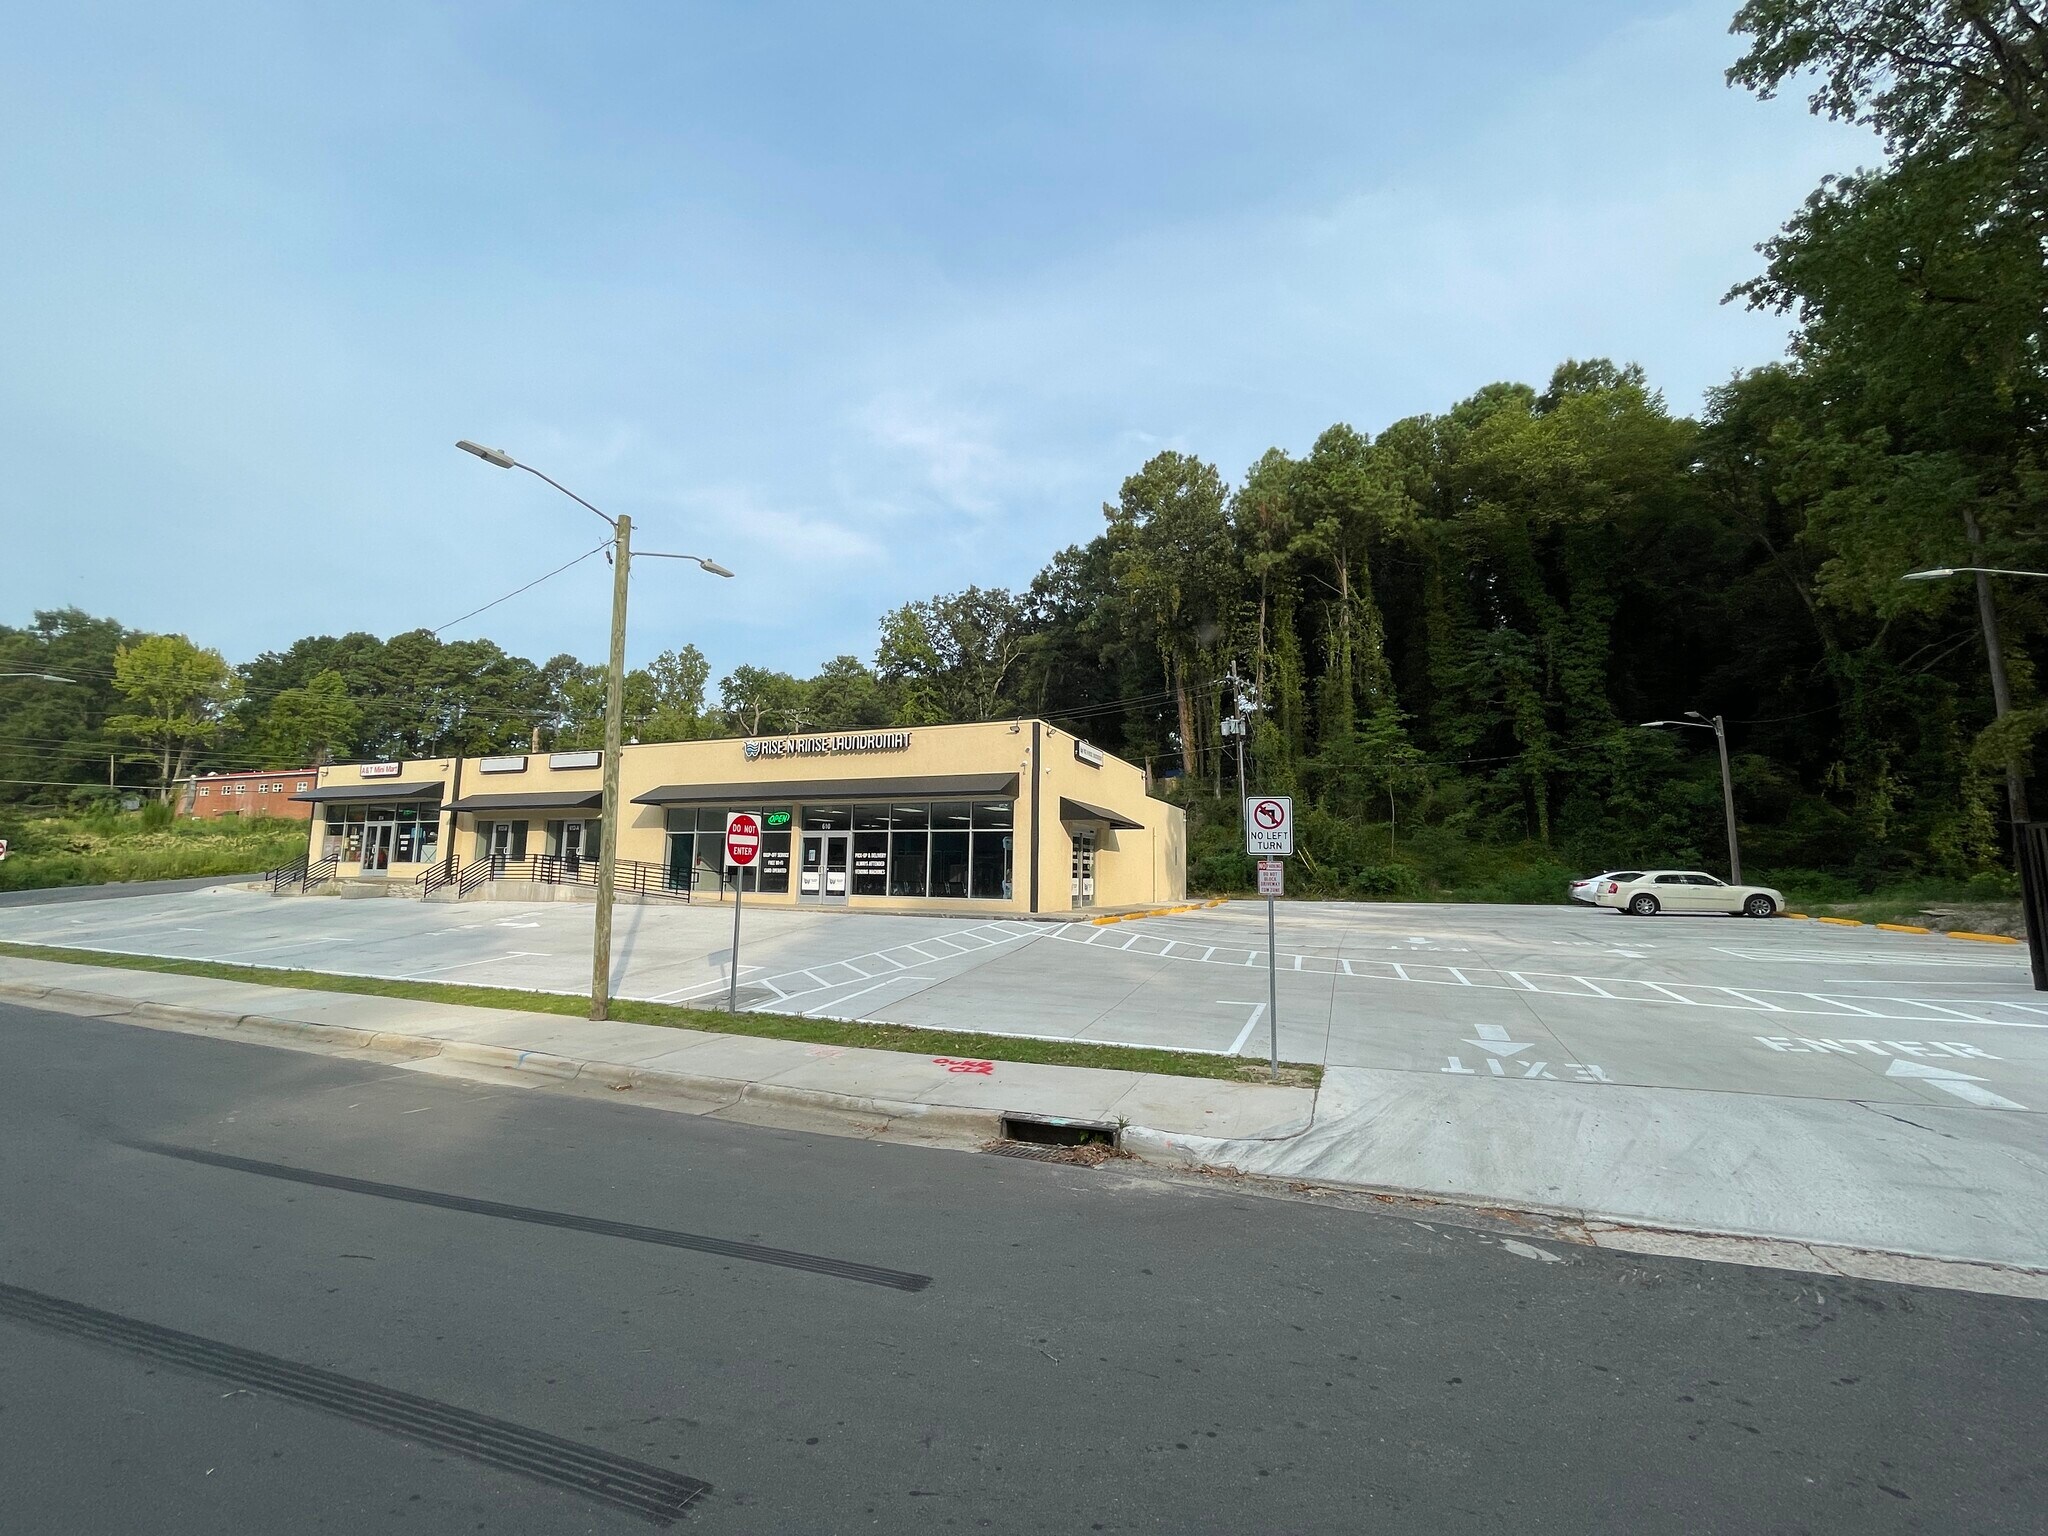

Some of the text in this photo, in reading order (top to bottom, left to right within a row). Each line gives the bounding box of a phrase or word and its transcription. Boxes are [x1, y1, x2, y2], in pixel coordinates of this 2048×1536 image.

[761, 732, 911, 755] RISE N RINSE LAUNDROMAT
[769, 814, 787, 823] OPEN
[732, 823, 756, 834] DO NOT
[1250, 831, 1288, 840] NO LEFT
[1258, 841, 1283, 850] TURN
[734, 846, 753, 856] ENTER
[1752, 1036, 2005, 1060] ENTER
[1441, 1056, 1614, 1083] EXIT
